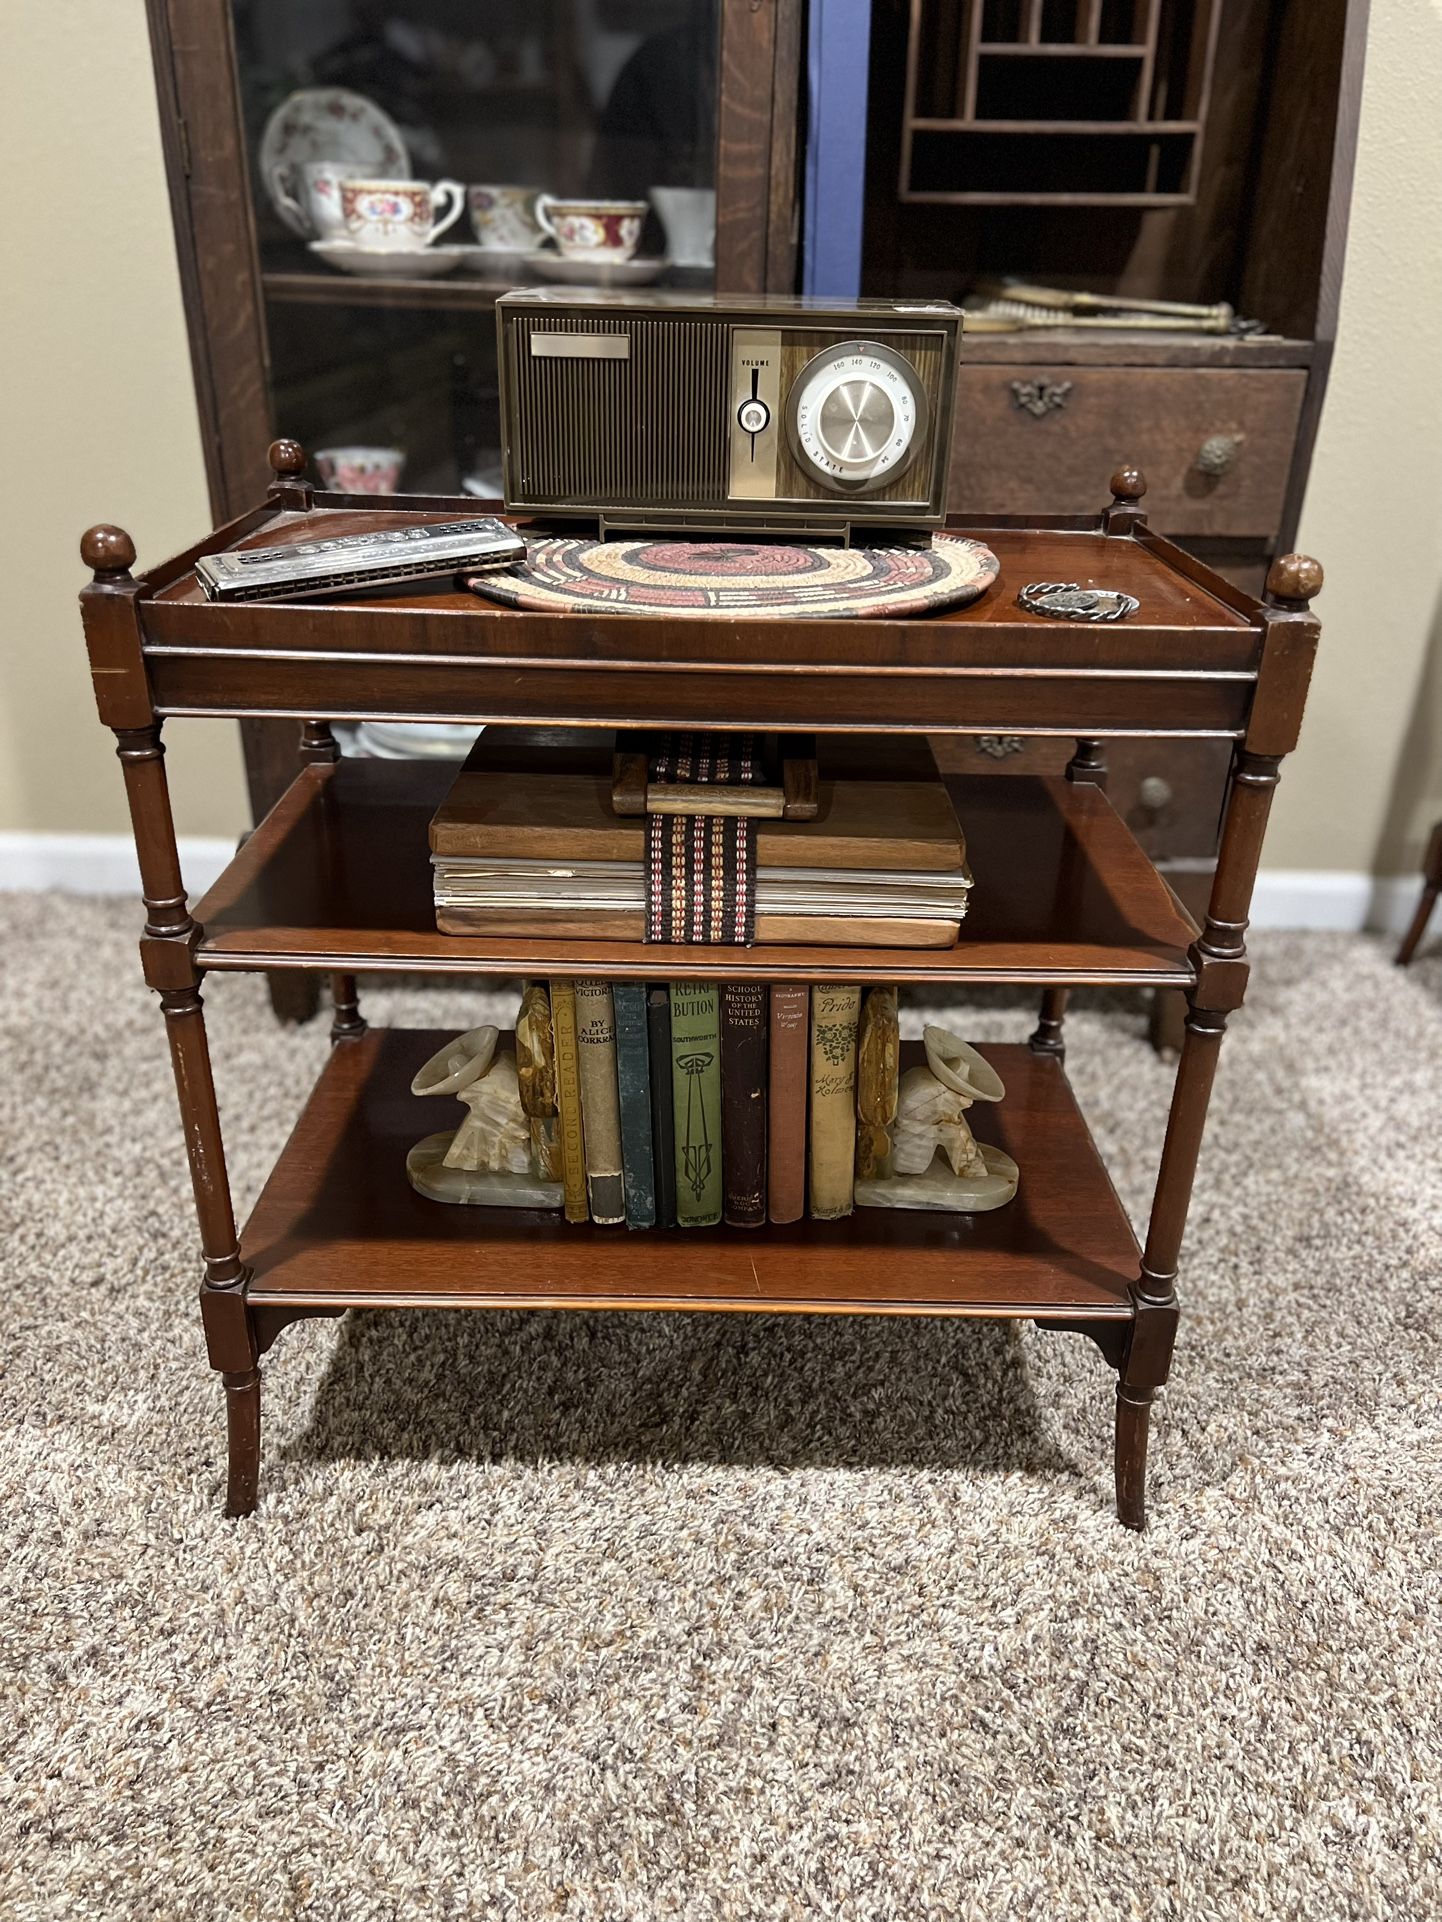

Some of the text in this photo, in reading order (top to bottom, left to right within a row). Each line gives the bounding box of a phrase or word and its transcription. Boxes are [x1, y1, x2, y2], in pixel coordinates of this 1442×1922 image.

[741, 359, 770, 367] VOLUME
[833, 361, 846, 371] 160
[851, 358, 863, 367] 140
[869, 360, 882, 371] 120
[886, 371, 898, 383] 100
[901, 395, 908, 406] 80
[903, 413, 910, 423] 70
[800, 404, 845, 474] SOLID STATE
[895, 437, 904, 448] 60
[727, 984, 762, 994] SCHOOL
[725, 993, 764, 1003] HISTORY
[673, 998, 715, 1018] BUTION
[820, 996, 856, 1013] Pride
[728, 1008, 761, 1017] UNITED
[590, 1019, 605, 1028] BY
[728, 1017, 760, 1027] STATES
[580, 1025, 614, 1036] ALICE
[672, 1032, 718, 1044] SOUTHWORTH
[560, 1023, 580, 1176] SECOND READER
